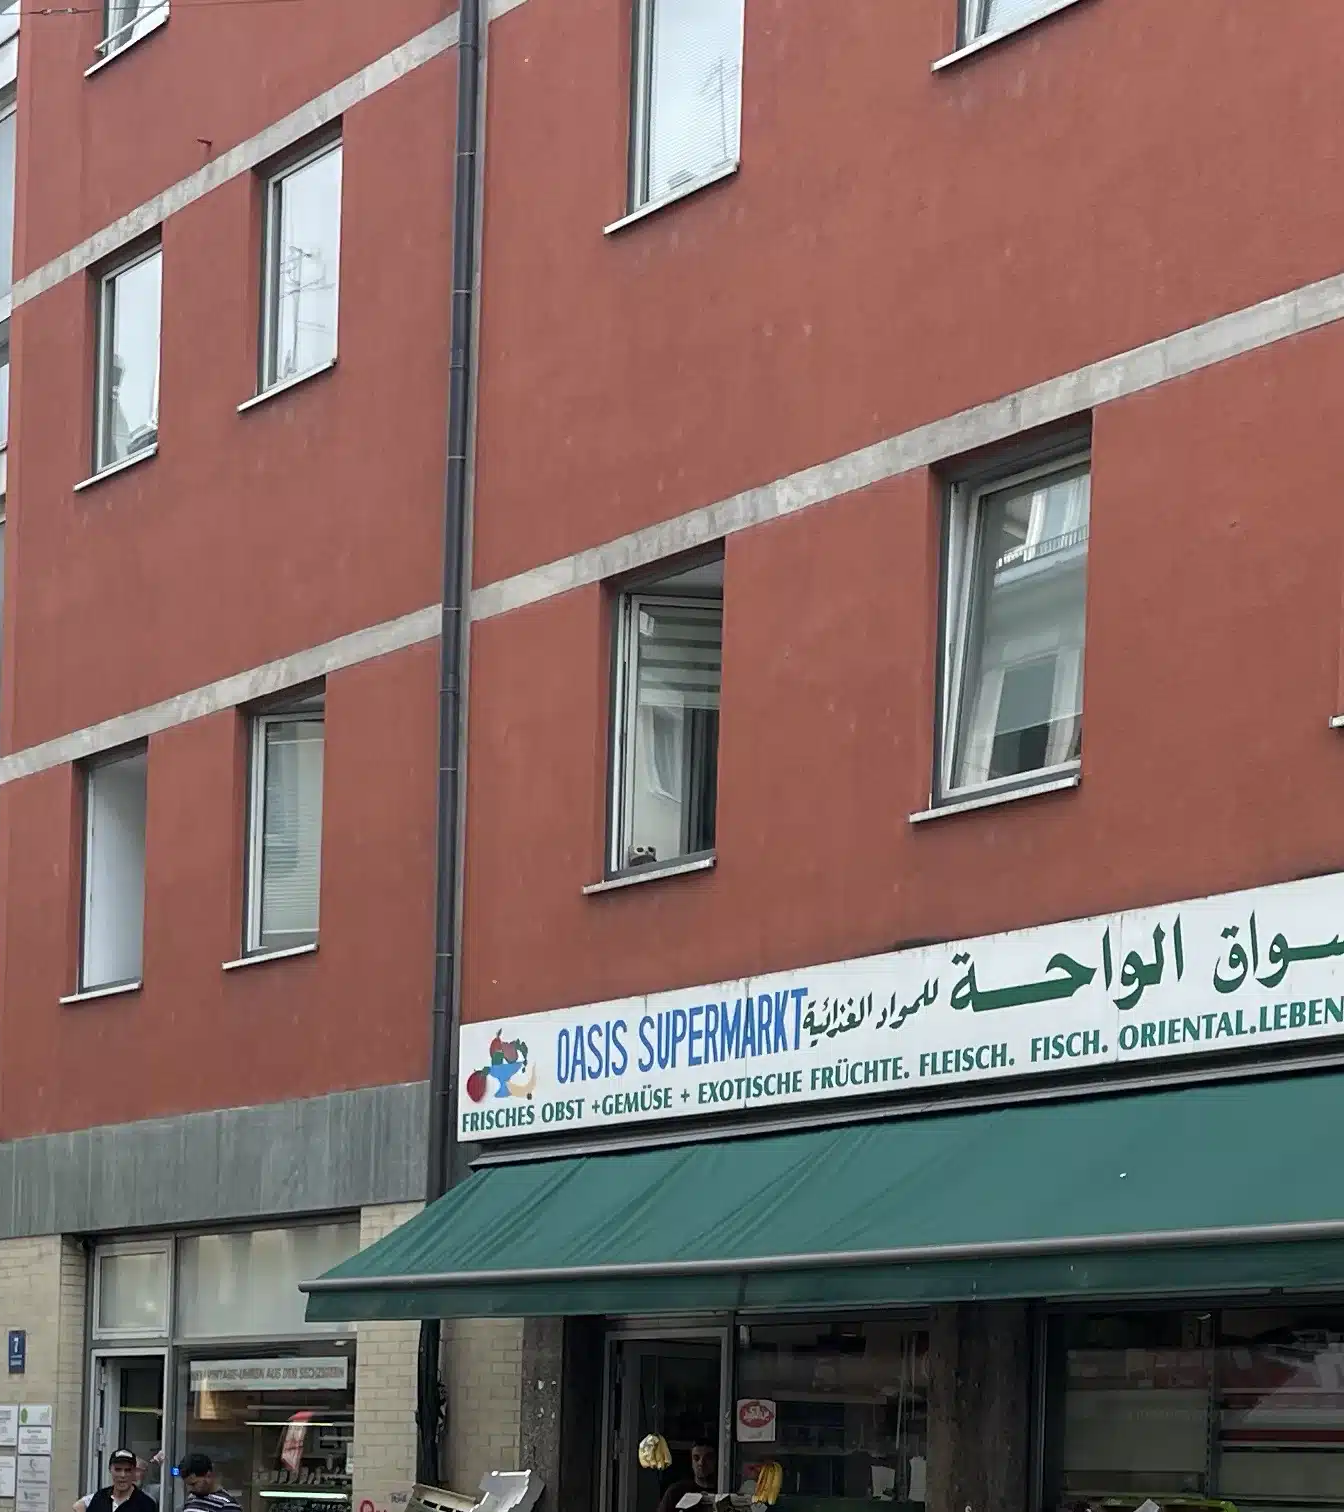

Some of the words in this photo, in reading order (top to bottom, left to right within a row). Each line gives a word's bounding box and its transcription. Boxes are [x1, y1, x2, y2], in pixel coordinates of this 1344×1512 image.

[462, 1106, 536, 1135] FRISCHES
[541, 1098, 586, 1124] OBST
[697, 1069, 803, 1106] EXOTISCHE
[809, 1055, 911, 1094] FRÜCHTE.
[918, 1042, 1016, 1079] FLEISCH.
[1029, 1029, 1110, 1063] FISCH.
[557, 1023, 629, 1084] OASIS
[637, 986, 809, 1075] SUPERMARKT
